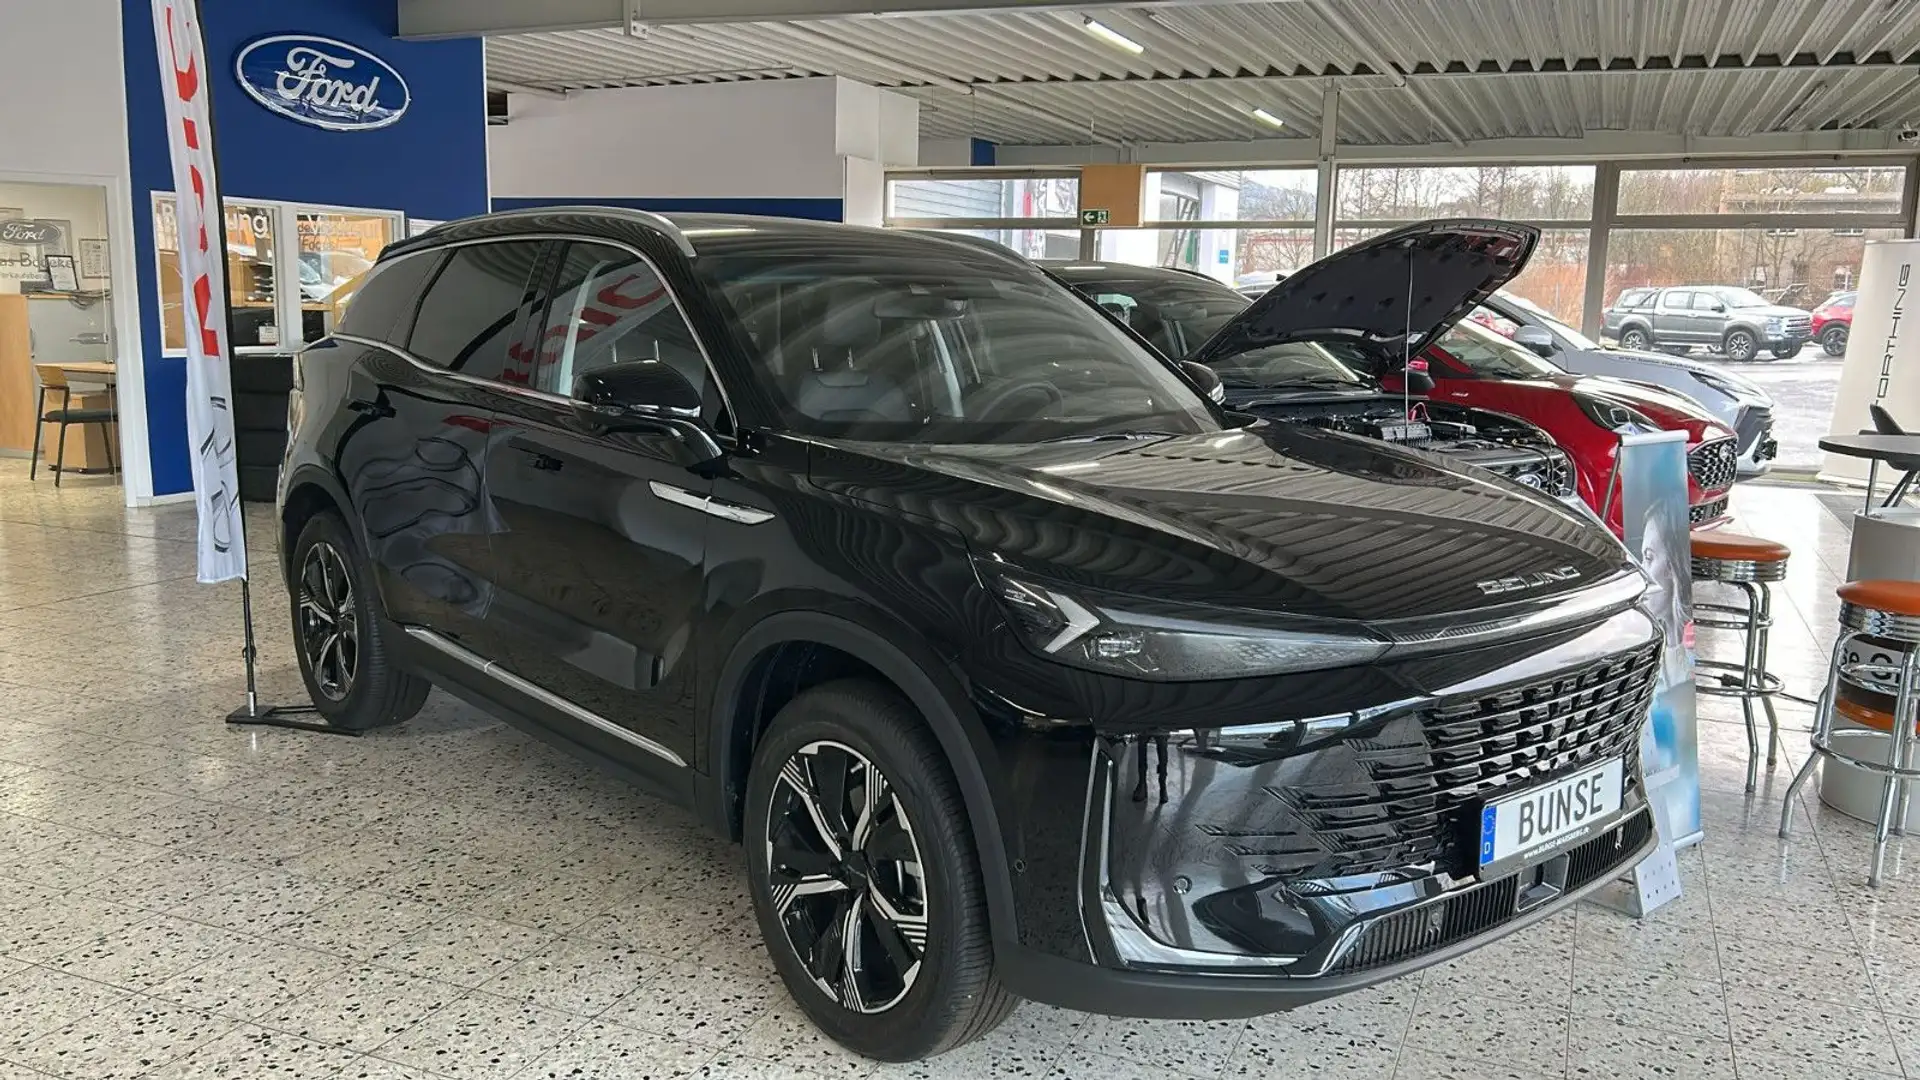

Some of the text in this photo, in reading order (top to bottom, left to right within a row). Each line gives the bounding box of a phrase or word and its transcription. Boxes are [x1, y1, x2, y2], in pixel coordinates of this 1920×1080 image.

[275, 47, 380, 113] Ford
[2, 223, 47, 240] Ford
[1876, 263, 1911, 405] ORTHING
[1518, 772, 1604, 845] BUNSE
[1484, 842, 1491, 855] D
